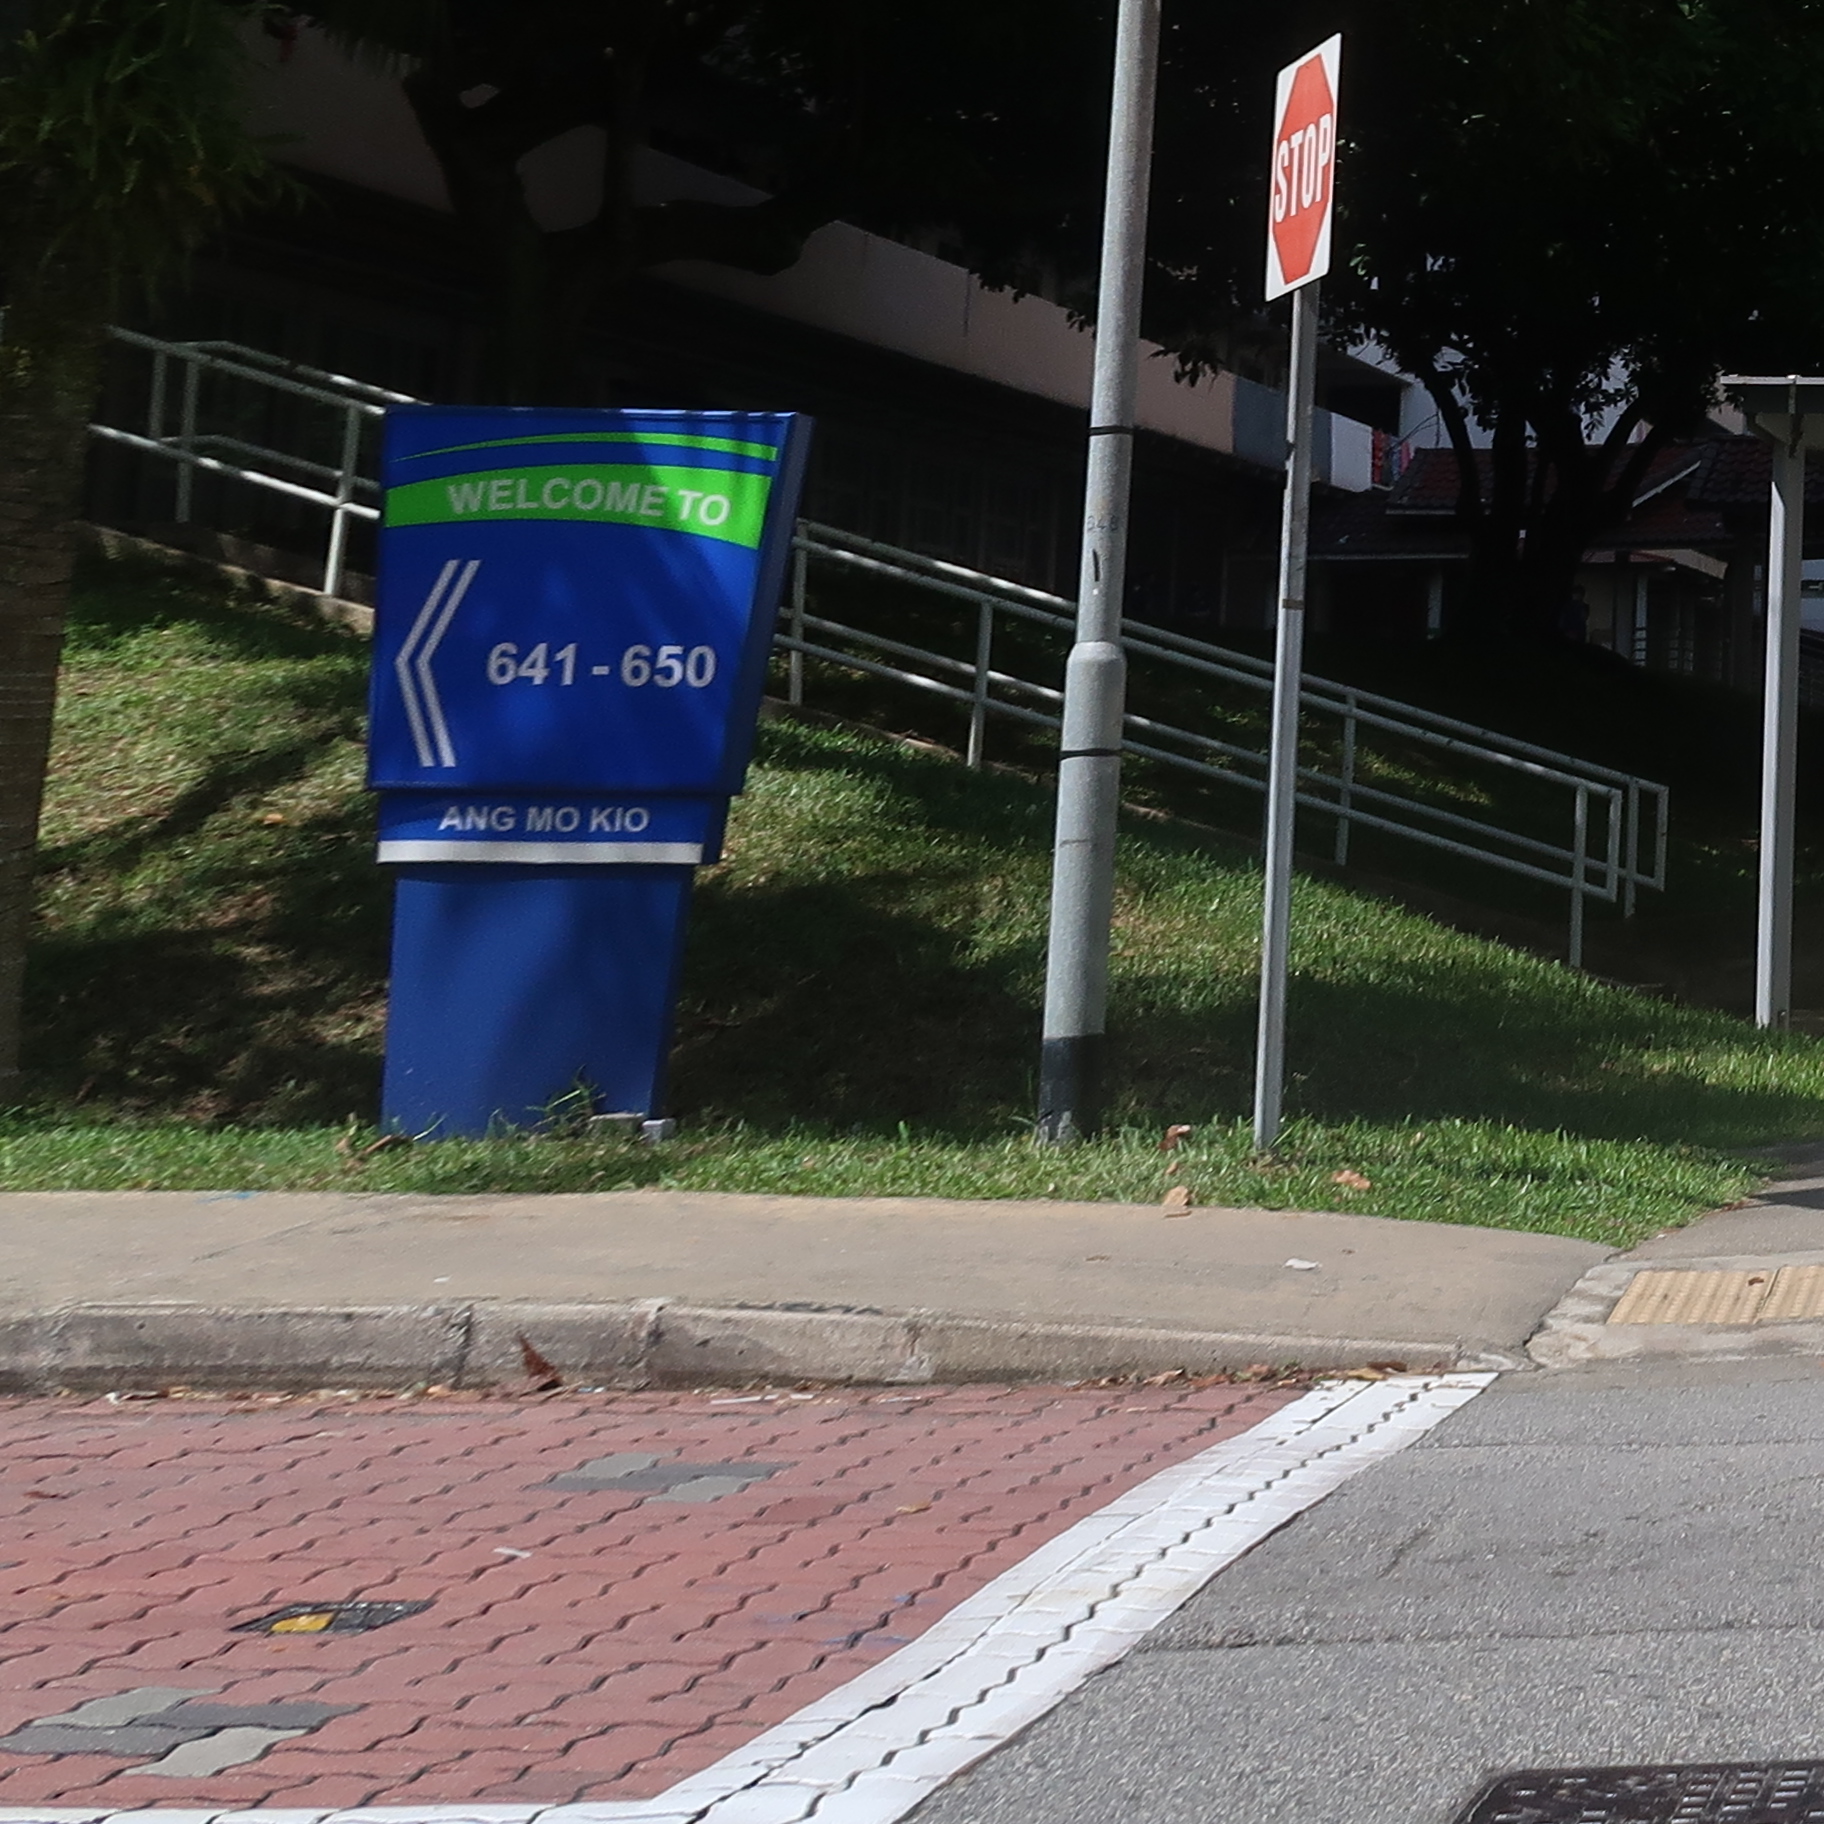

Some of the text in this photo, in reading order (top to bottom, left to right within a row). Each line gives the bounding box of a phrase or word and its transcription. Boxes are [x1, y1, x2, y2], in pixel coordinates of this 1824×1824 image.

[1275, 112, 1332, 223] STOP
[448, 477, 731, 527] WELCOME TO
[487, 642, 716, 688] 641 - 650
[437, 805, 649, 833] ANG MO KIO
